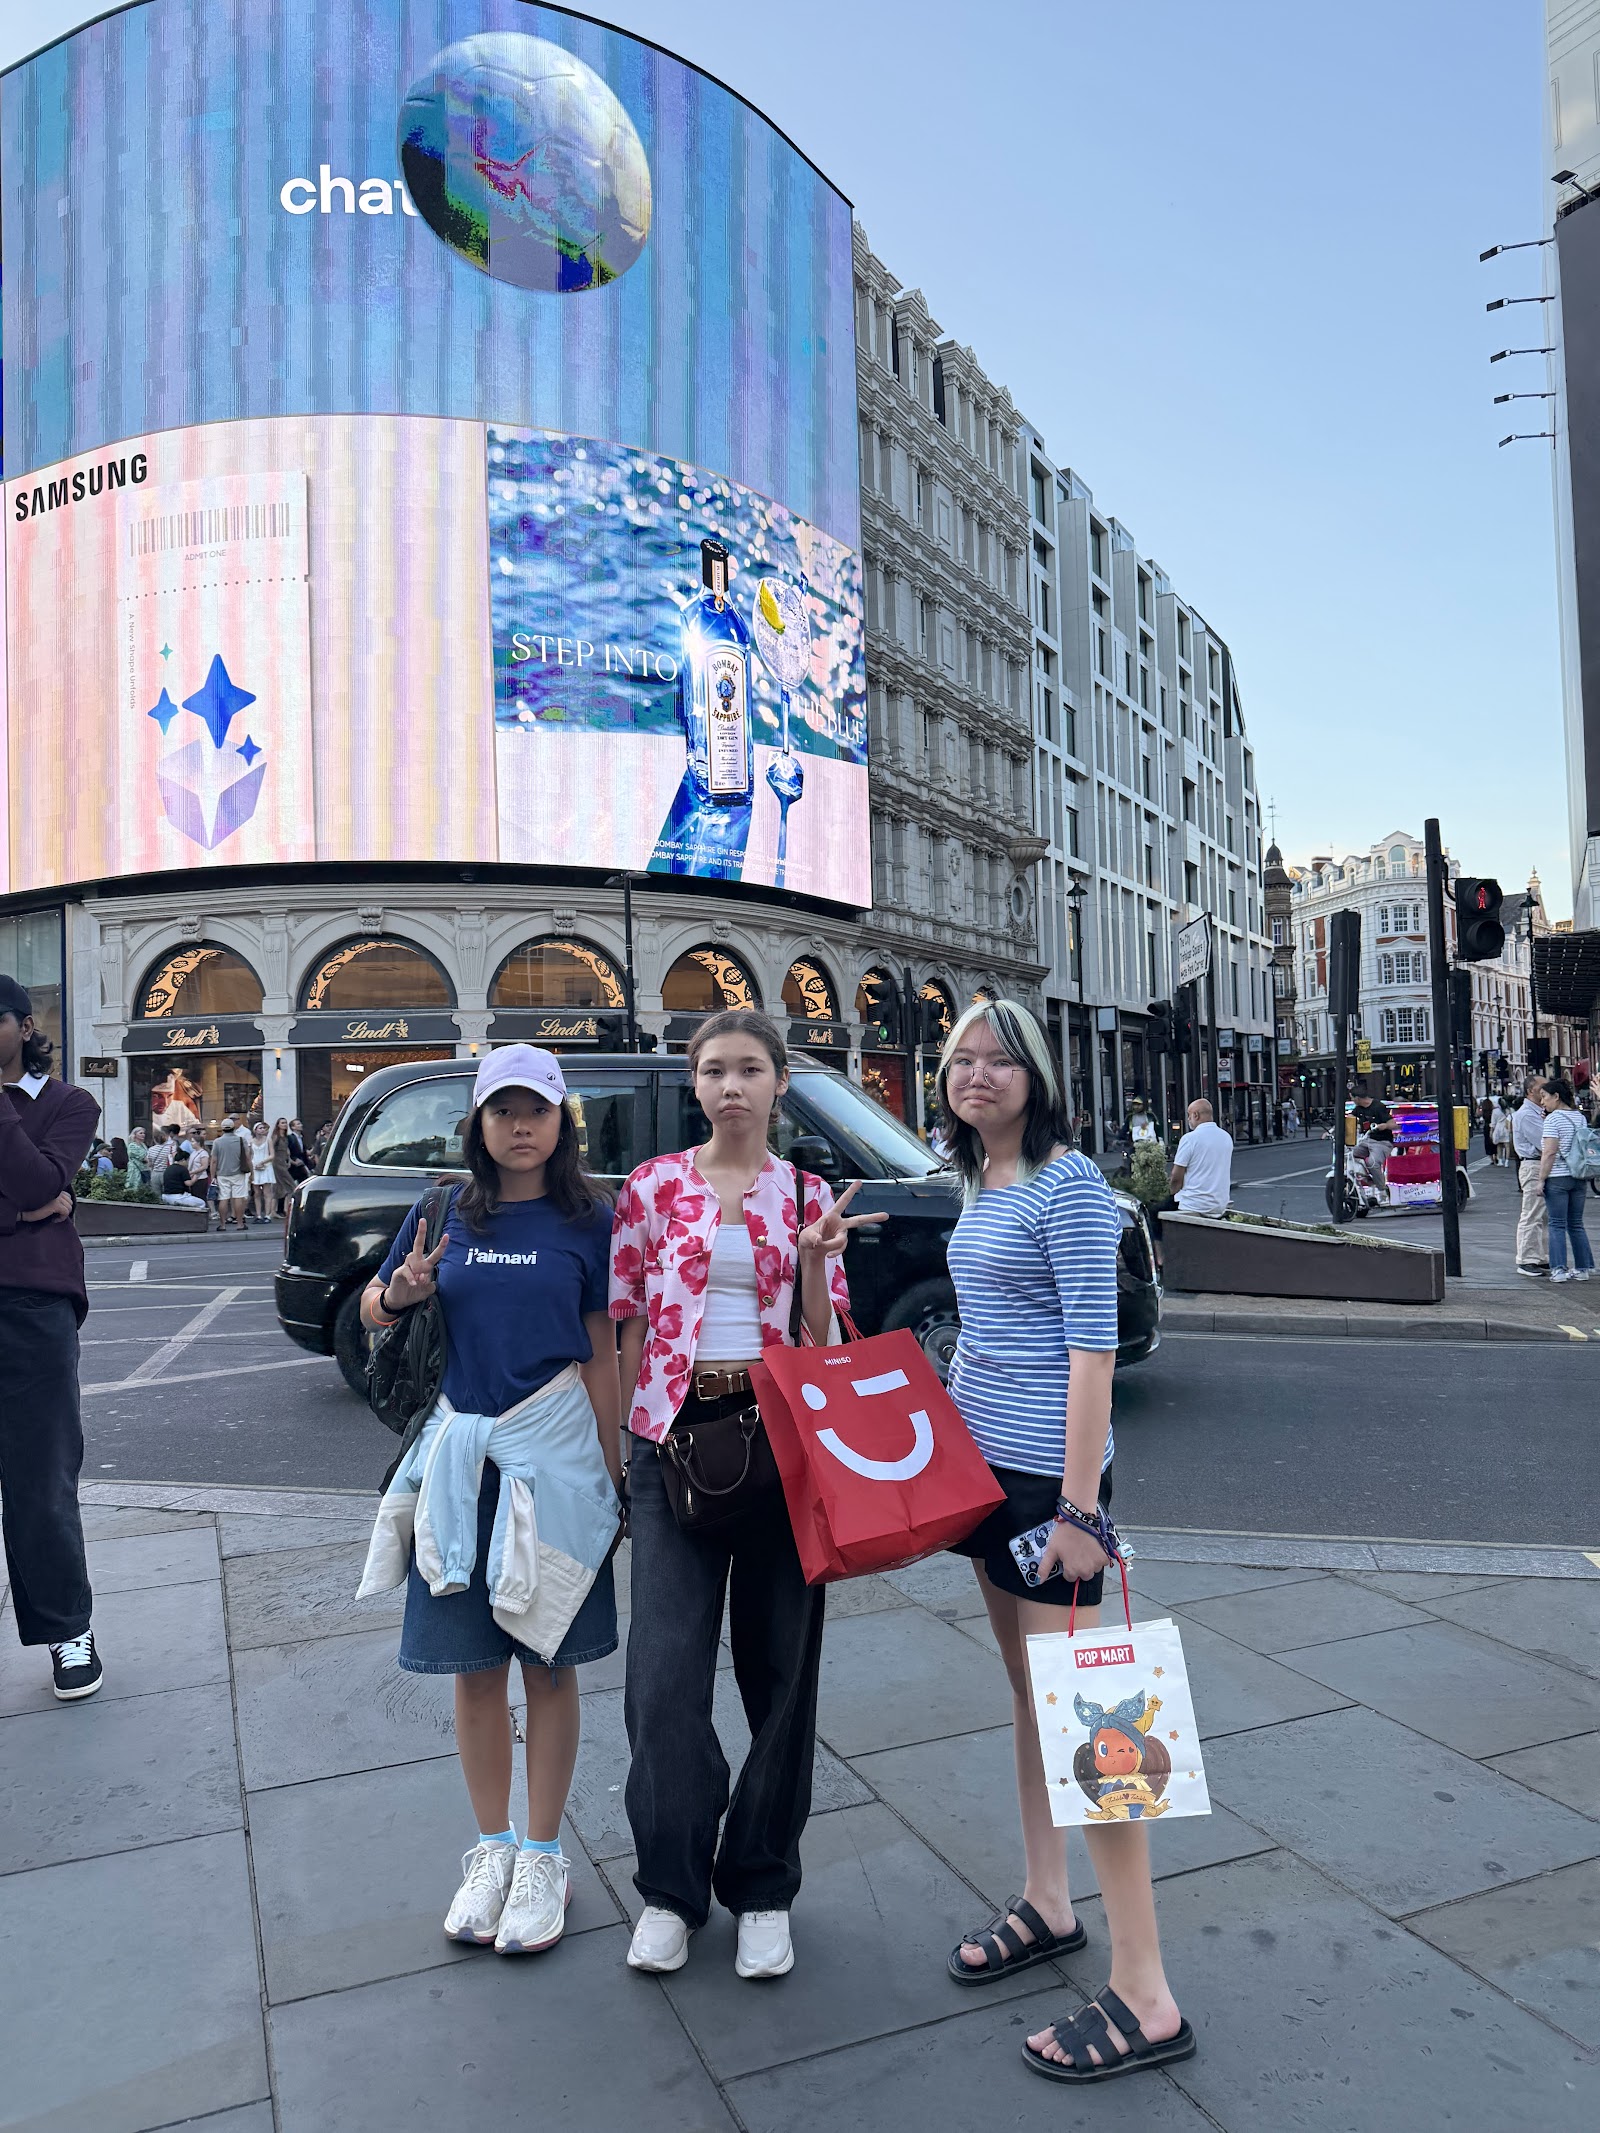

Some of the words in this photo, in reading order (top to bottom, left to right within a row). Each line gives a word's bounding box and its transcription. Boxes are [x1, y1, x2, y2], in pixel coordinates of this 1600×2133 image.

[15, 453, 147, 522] SAMSUNG
[185, 551, 207, 561] ADMIT
[209, 549, 226, 558] ONE
[128, 644, 136, 673] Shape
[511, 632, 594, 667] STEP
[605, 643, 678, 682] INTO
[712, 659, 739, 675] BOMBAY
[827, 708, 864, 745] BLUE
[655, 840, 683, 849] BOMBAY
[645, 850, 675, 860] BOMBAY
[708, 858, 722, 866] AND
[1192, 943, 1203, 957] Square
[341, 1020, 396, 1039] Lindt
[535, 1018, 586, 1036] Lindt
[162, 1028, 208, 1047] Lindt
[464, 1247, 538, 1266] j'aimavi
[824, 1356, 852, 1366] MINISO
[1077, 1650, 1098, 1666] POP
[1100, 1647, 1130, 1664] MART
